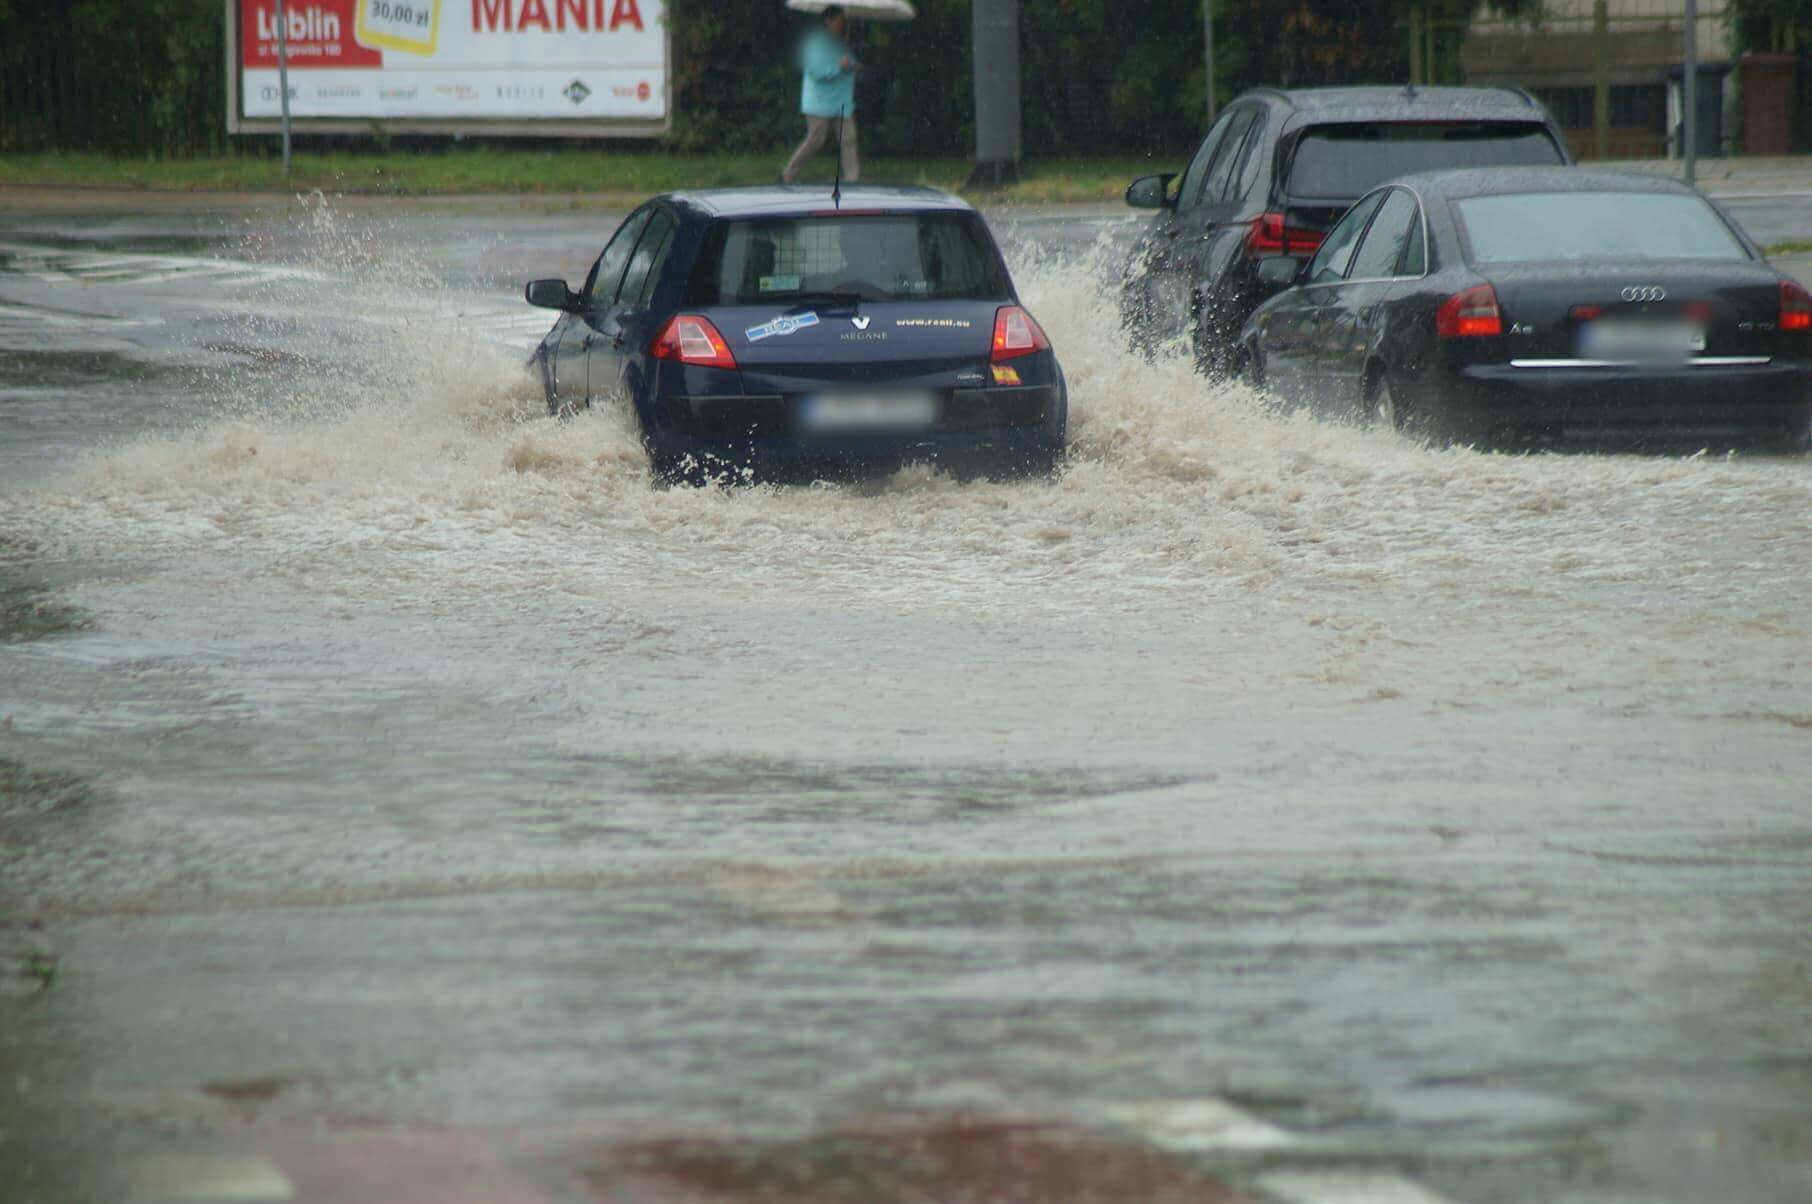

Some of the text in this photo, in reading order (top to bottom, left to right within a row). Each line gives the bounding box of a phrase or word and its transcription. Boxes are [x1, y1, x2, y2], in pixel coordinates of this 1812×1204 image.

[257, 7, 340, 41] Lublin
[371, 0, 413, 24] 30,00
[470, 0, 645, 33] MANIA
